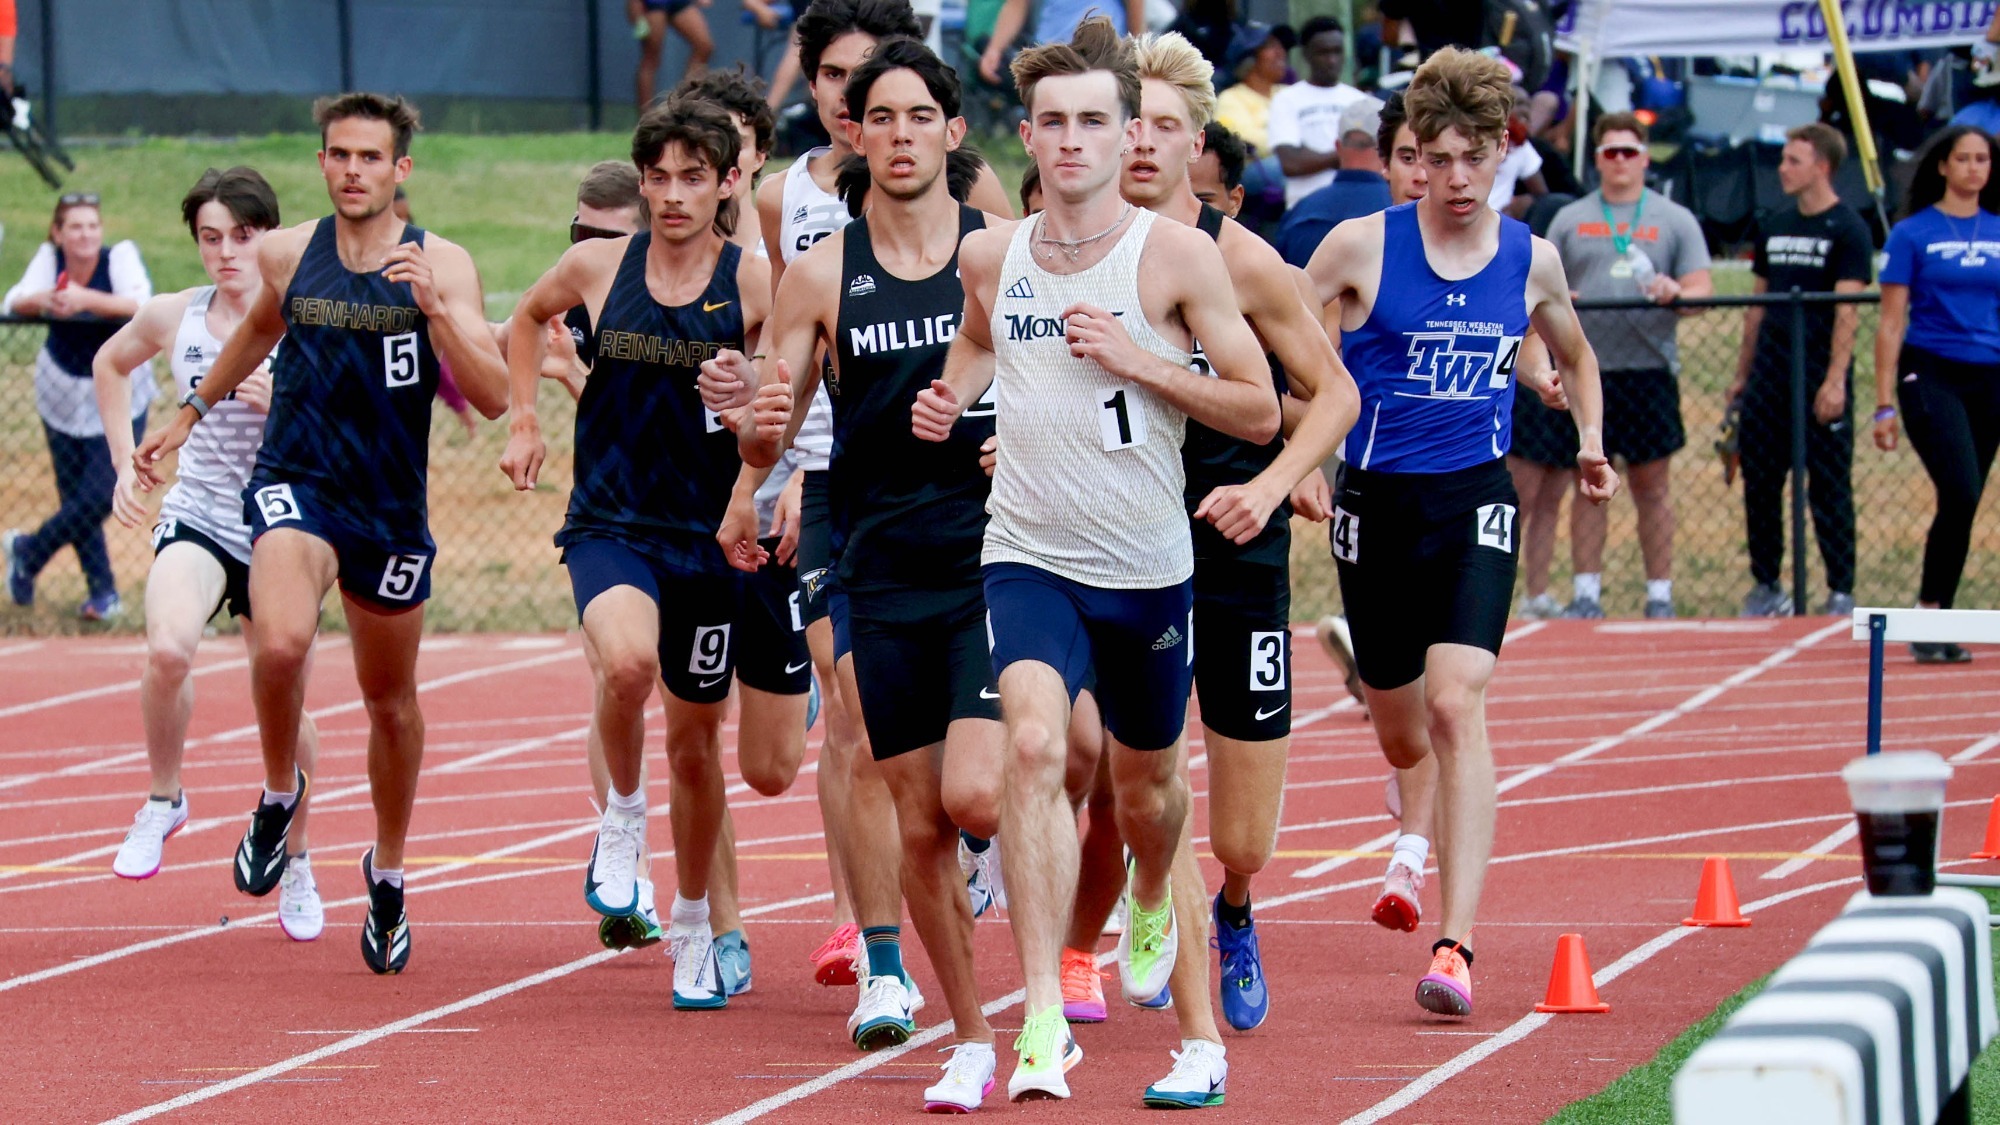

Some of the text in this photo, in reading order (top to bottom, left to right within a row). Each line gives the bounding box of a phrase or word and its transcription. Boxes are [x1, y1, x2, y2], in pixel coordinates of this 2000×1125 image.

[291, 297, 419, 333] REINHARDT
[850, 312, 964, 356] MILLIG
[1426, 320, 1504, 330] TENNESSEE WESLEYAN
[391, 337, 414, 381] 5
[1497, 340, 1520, 384] 4
[1104, 390, 1132, 445] 1
[261, 488, 292, 518] 5
[1336, 514, 1353, 558] 4
[1483, 505, 1507, 547] 4
[386, 555, 419, 595] 5
[698, 628, 725, 671] 9
[1152, 633, 1183, 651] adidas
[1256, 636, 1281, 687] 3
